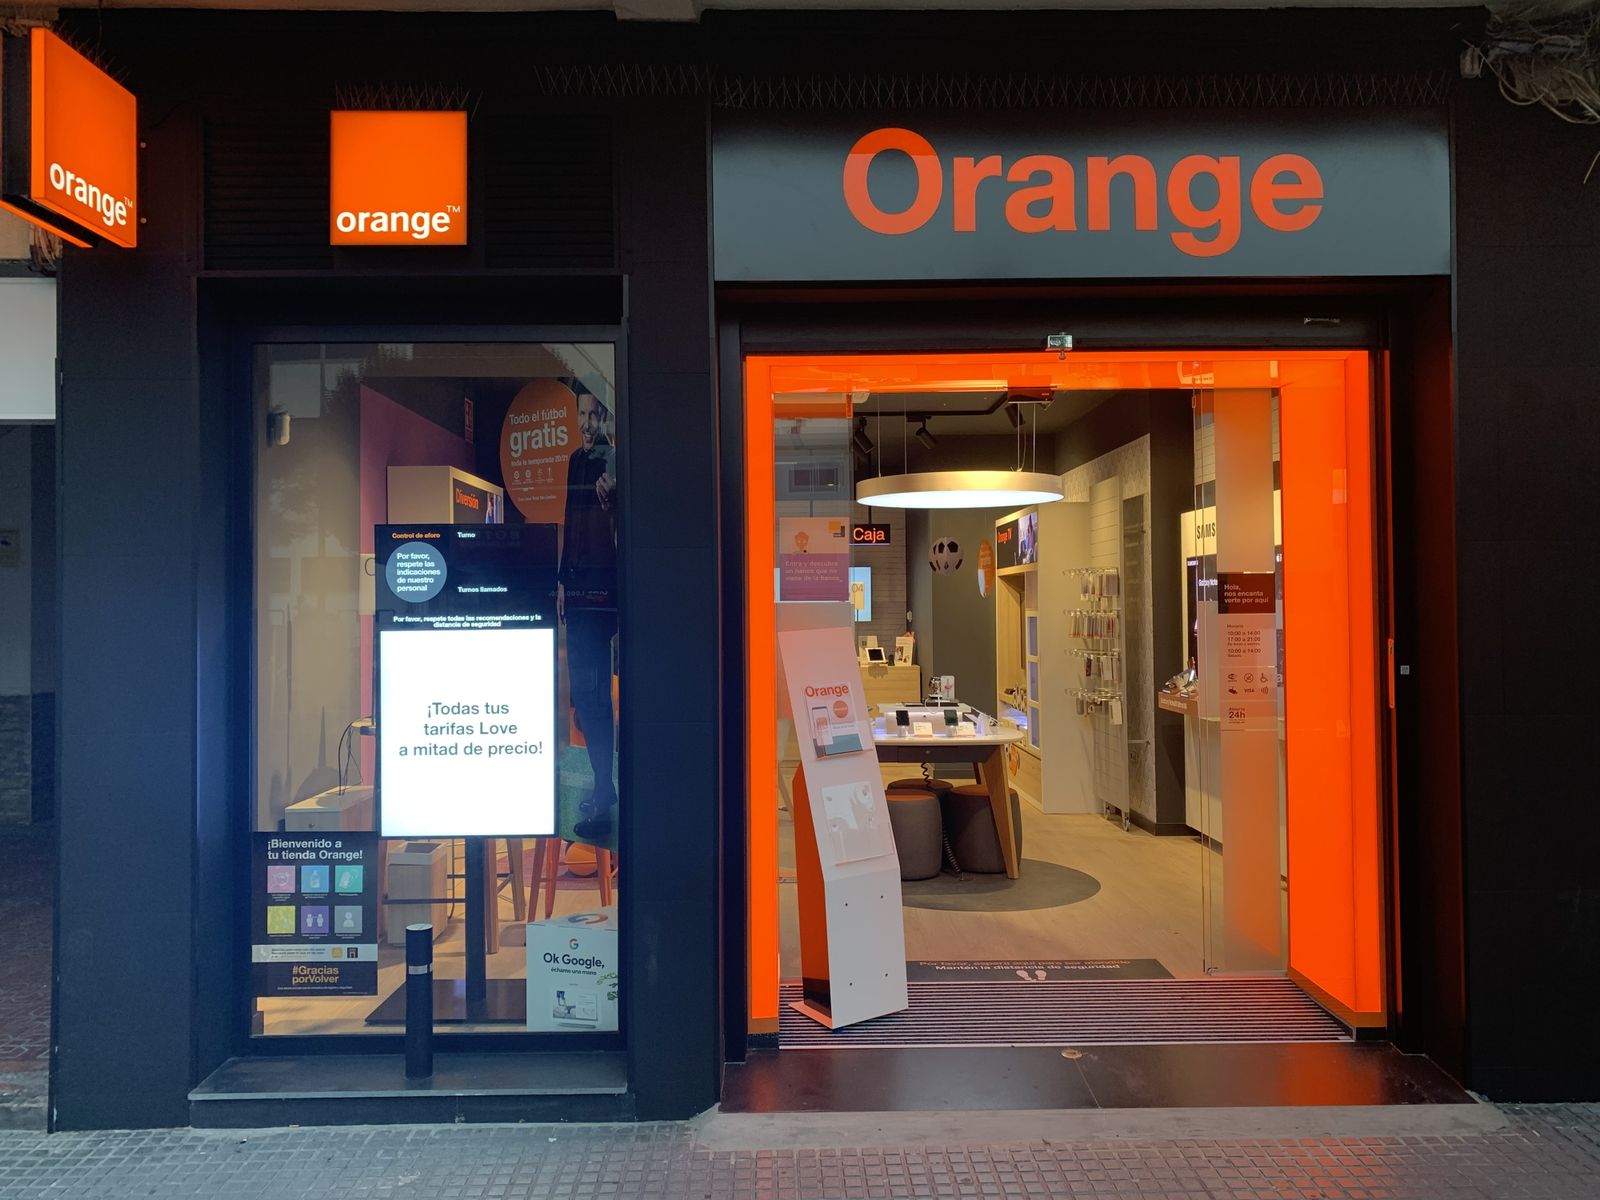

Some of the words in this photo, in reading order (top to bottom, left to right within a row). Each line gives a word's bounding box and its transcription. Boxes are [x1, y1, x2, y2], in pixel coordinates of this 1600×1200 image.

[49, 162, 127, 227] orange
[843, 127, 1324, 257] Orange
[335, 209, 450, 239] orange
[509, 414, 530, 425] Todo
[532, 411, 540, 422] el
[541, 407, 567, 420] fútbol
[509, 421, 569, 457] gratis
[853, 528, 886, 544] Caja
[1196, 521, 1216, 540] SAMS
[396, 561, 424, 569] respete
[396, 584, 428, 592] personal
[805, 684, 849, 697] Orange
[427, 702, 480, 718] ¡Todas
[485, 703, 509, 714] tus
[424, 722, 474, 735] tarifas
[480, 722, 518, 735] Love
[399, 746, 408, 756] a
[413, 743, 458, 756] mitad
[464, 742, 483, 755] de
[488, 741, 543, 758] precio!
[267, 839, 332, 850] ¡Bienvenido
[267, 851, 279, 860] tu
[282, 850, 316, 860] tienda
[319, 850, 363, 861] Orange!
[543, 953, 559, 964] Ok
[562, 954, 605, 969] Google,
[292, 965, 339, 975] #Gracias
[292, 975, 340, 984] porVolver
